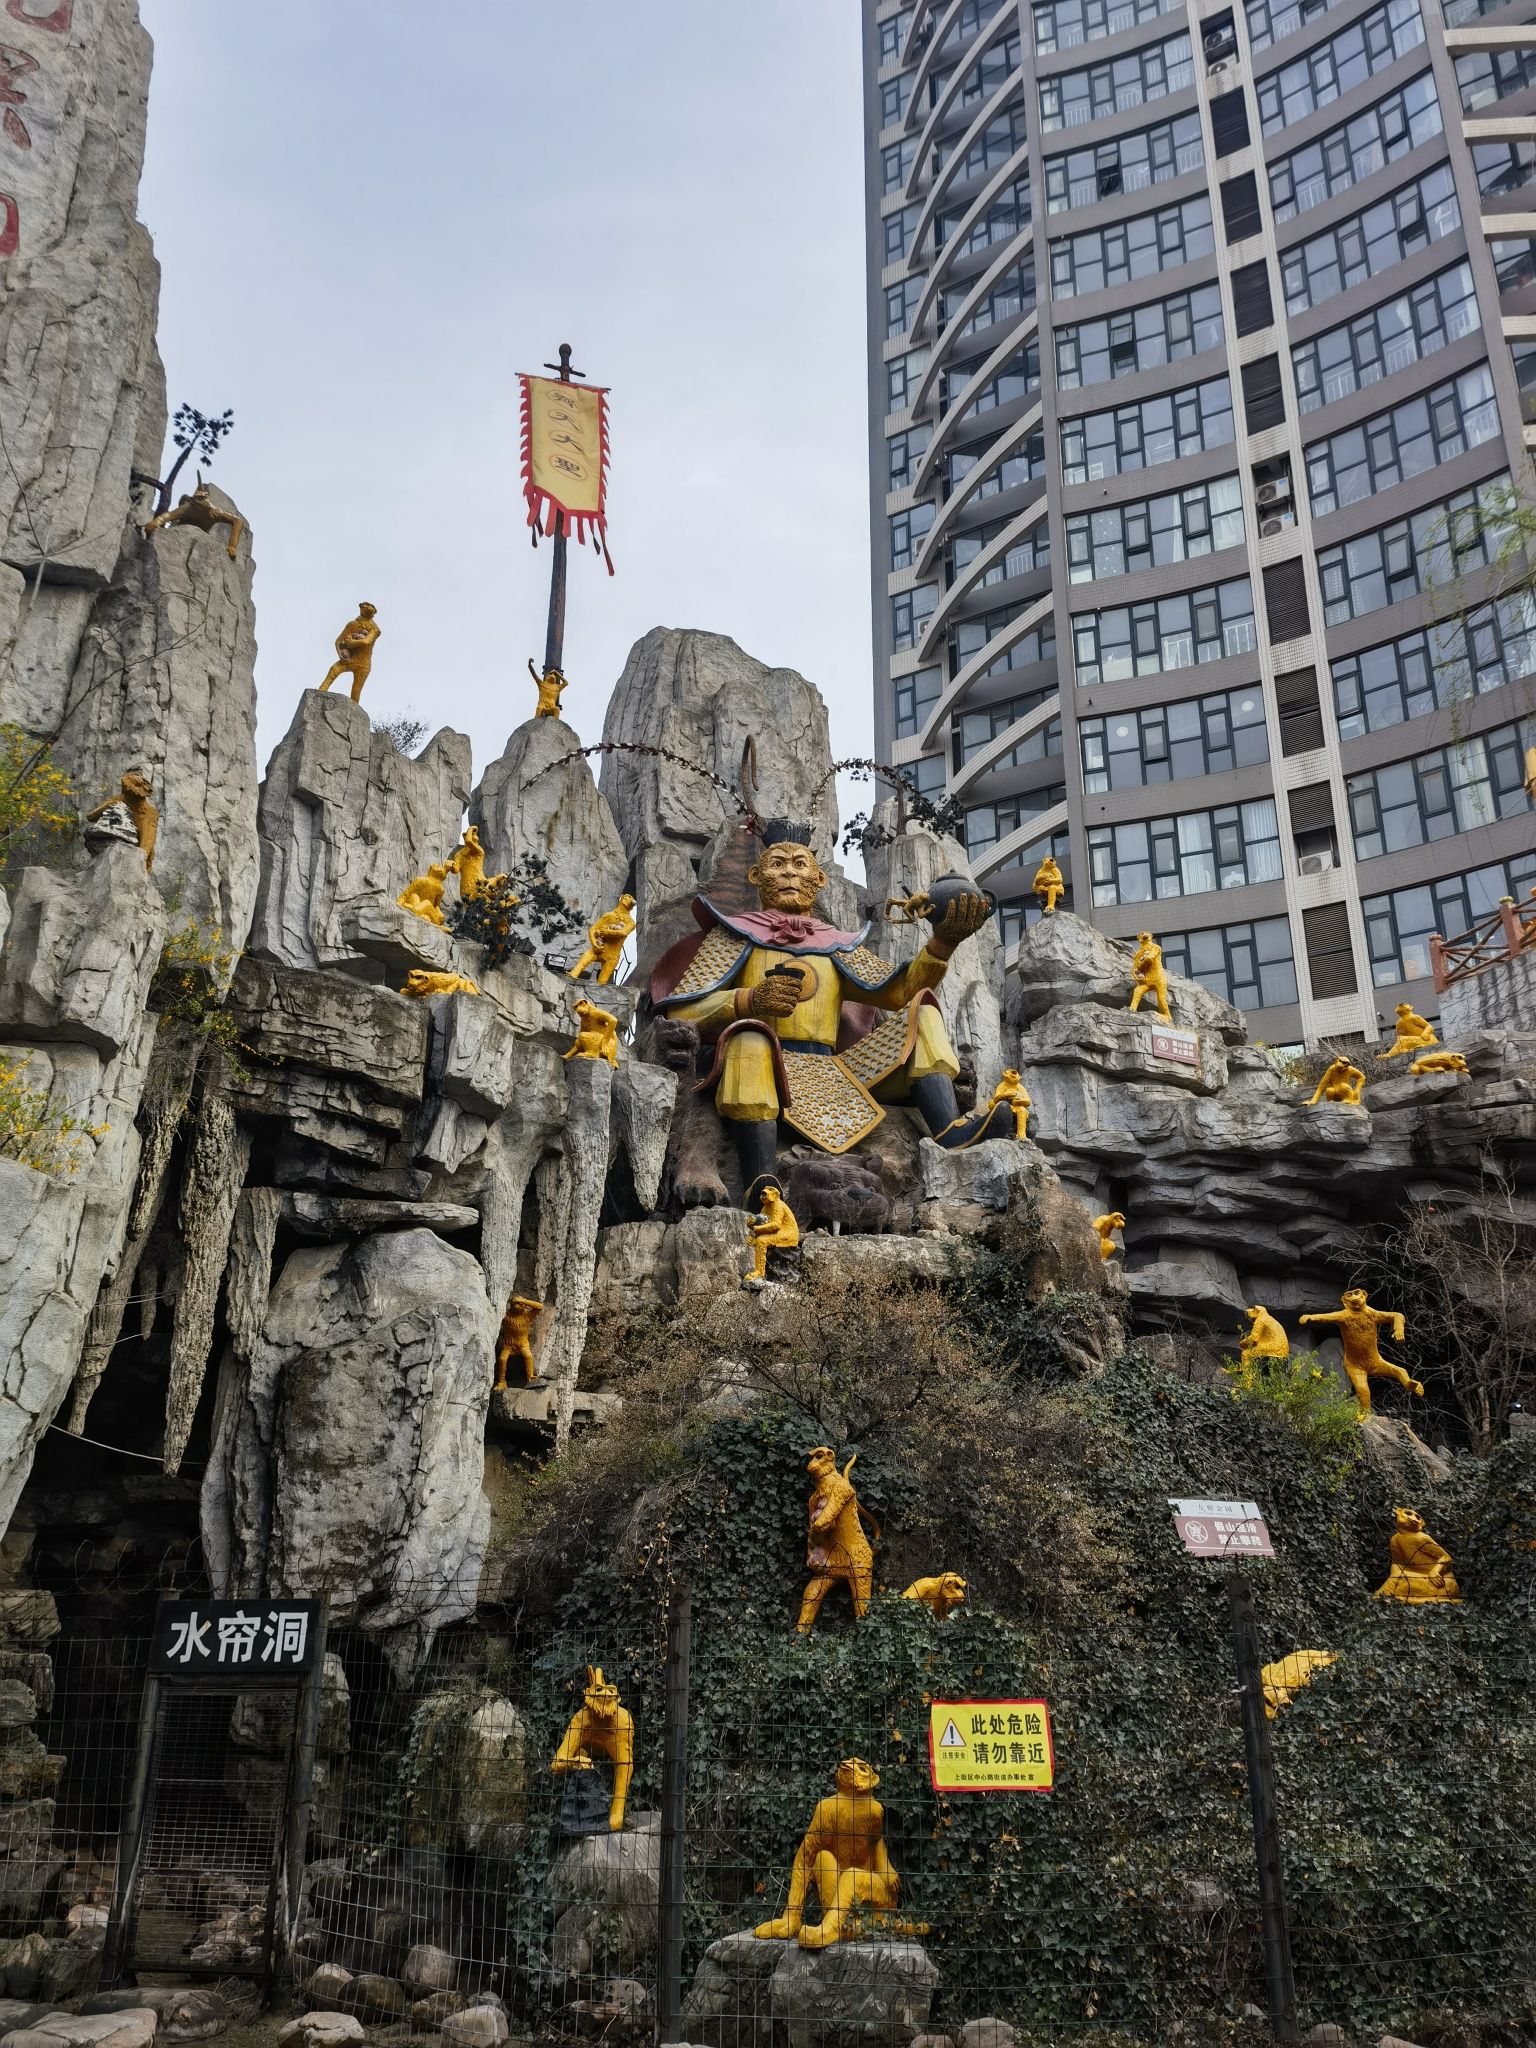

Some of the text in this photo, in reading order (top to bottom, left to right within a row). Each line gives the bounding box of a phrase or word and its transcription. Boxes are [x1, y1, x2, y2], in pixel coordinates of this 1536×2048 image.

[1214, 1521, 1257, 1533] 假山湿滑
[1218, 1534, 1263, 1546] 禁止攀爬
[166, 1610, 309, 1663] 水帘洞
[971, 1713, 1042, 1735] 此处危险
[942, 1751, 966, 1759] 注意安全
[972, 1742, 1045, 1764] 请勿靠近
